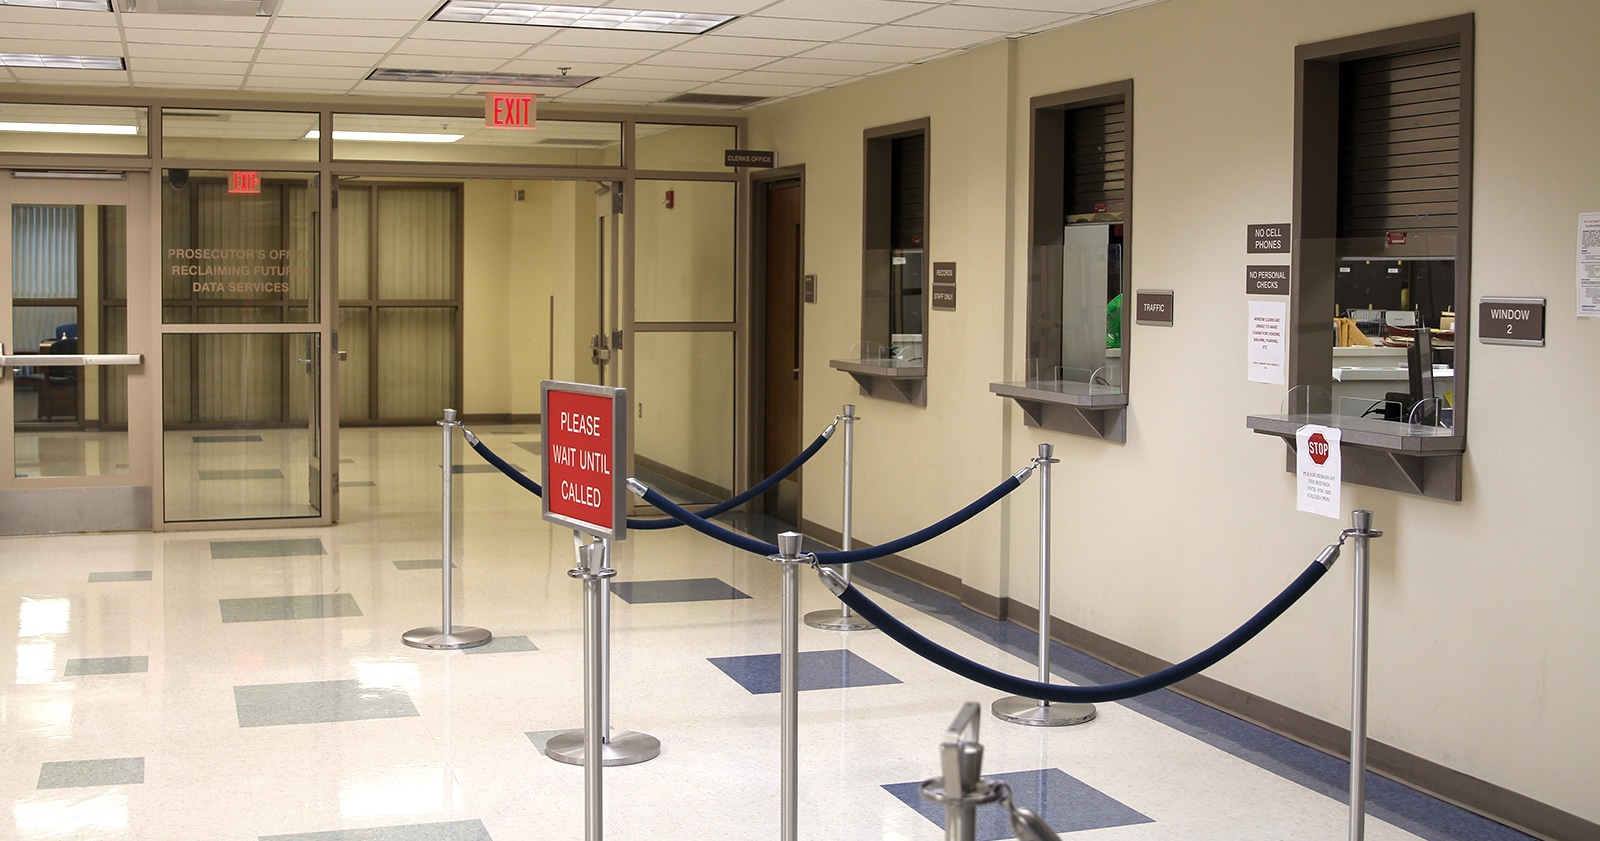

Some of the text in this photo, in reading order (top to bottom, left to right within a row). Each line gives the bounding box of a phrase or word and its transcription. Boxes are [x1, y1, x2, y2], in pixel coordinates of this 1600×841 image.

[493, 97, 532, 126] EXIT
[233, 172, 257, 191] EXIT
[1254, 228, 1282, 238] NO CELL
[1254, 240, 1282, 249] PHONES
[168, 248, 266, 260] PROSECUTOR'S
[171, 265, 250, 276] RECLAIMING
[1249, 271, 1286, 279] NO PERSONAL
[192, 282, 289, 293] DATA SERVICES
[1256, 281, 1279, 289] CHECKS
[1143, 303, 1165, 312] TRAFFIC
[1490, 309, 1530, 320] WINDOW
[1506, 324, 1513, 334] 2
[560, 411, 601, 437] PLEASE
[1309, 441, 1328, 456] STOP
[552, 444, 611, 475] WAIT UNTIL
[561, 480, 602, 508] CALLED
